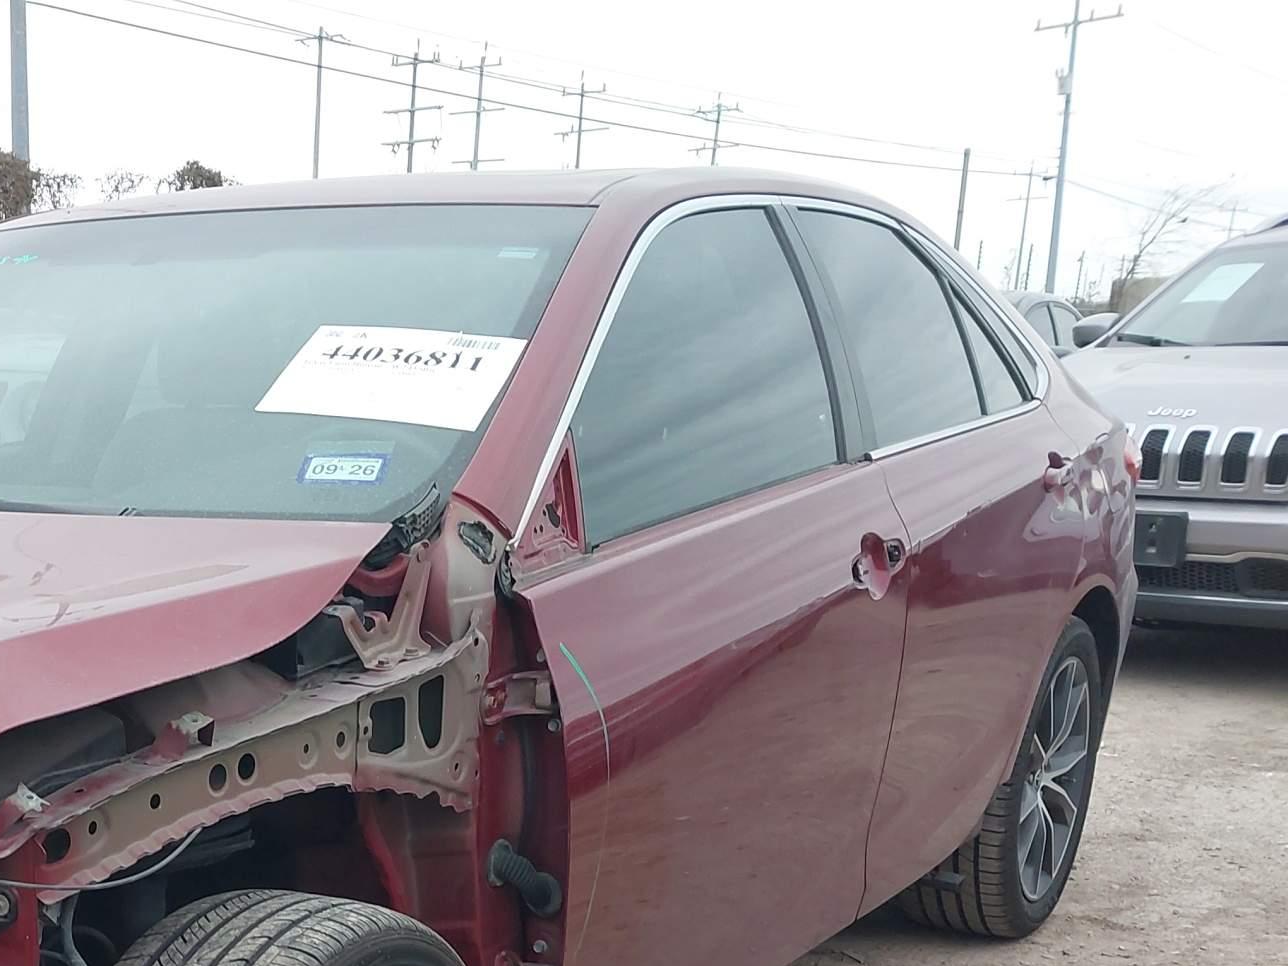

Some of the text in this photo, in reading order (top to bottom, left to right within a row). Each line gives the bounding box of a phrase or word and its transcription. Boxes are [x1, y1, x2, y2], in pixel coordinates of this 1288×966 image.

[321, 344, 484, 372] 44036811
[1146, 406, 1198, 419] Jeep
[312, 463, 376, 476] 09 26
